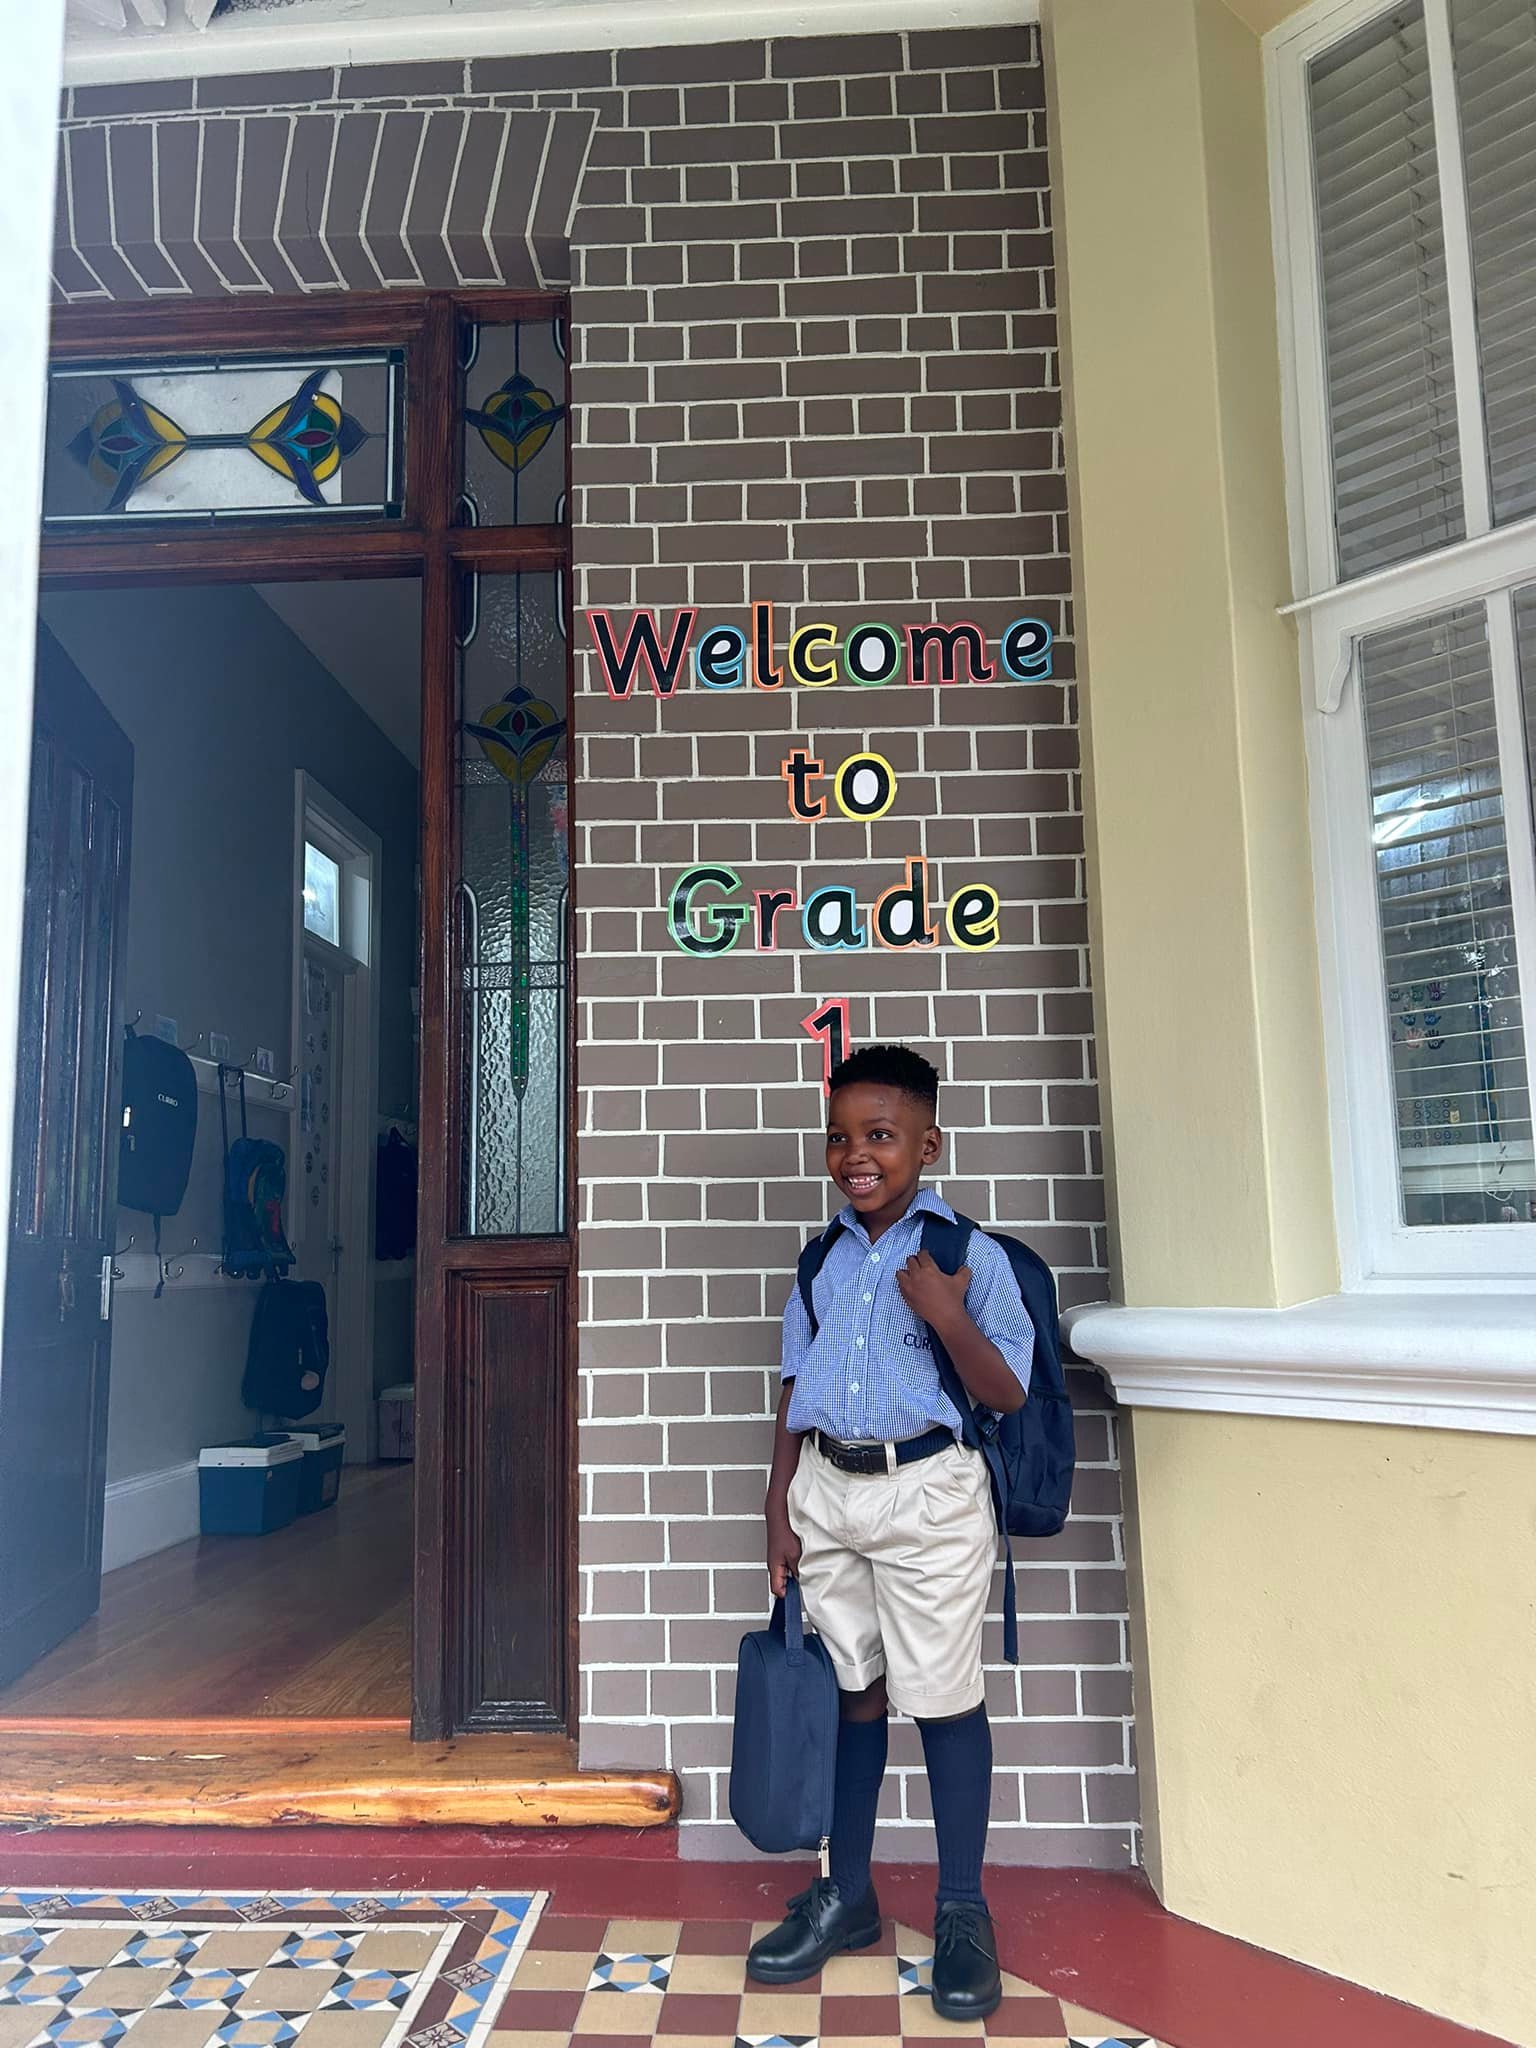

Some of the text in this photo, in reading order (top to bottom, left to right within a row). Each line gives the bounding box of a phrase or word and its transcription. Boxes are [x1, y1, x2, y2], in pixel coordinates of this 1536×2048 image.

[587, 601, 1053, 700] Welcome
[782, 749, 897, 823] to
[667, 856, 1000, 958] Grade
[801, 998, 850, 1098] 1
